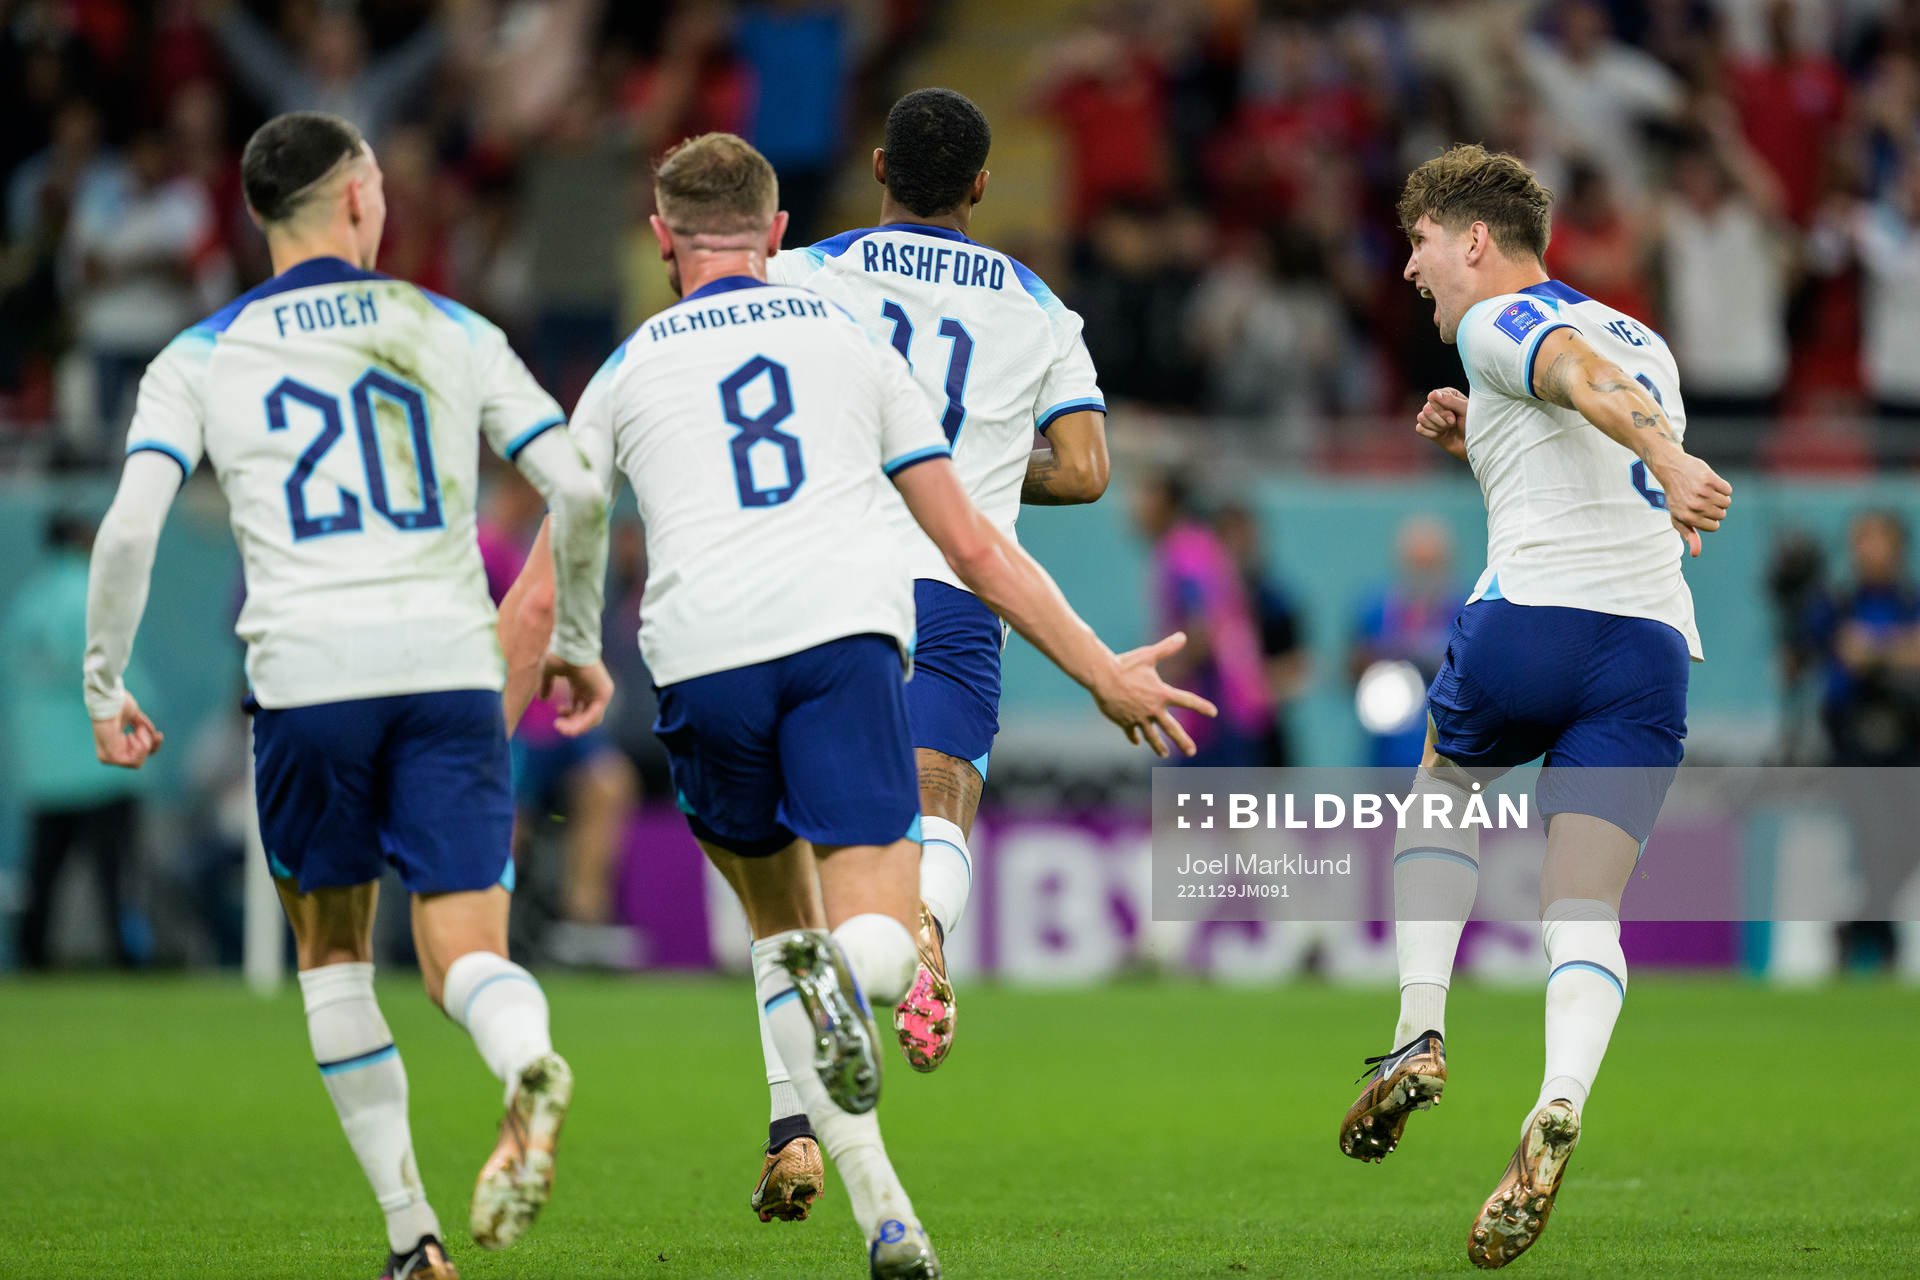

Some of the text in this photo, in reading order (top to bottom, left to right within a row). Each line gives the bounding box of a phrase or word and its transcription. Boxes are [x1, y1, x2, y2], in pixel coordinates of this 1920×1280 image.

[863, 240, 1005, 291] RASHFORD
[273, 292, 379, 338] FODEN
[649, 297, 829, 342] HENDERSON
[1601, 320, 1651, 346] NES
[263, 366, 445, 543] 20
[717, 352, 806, 510] 8
